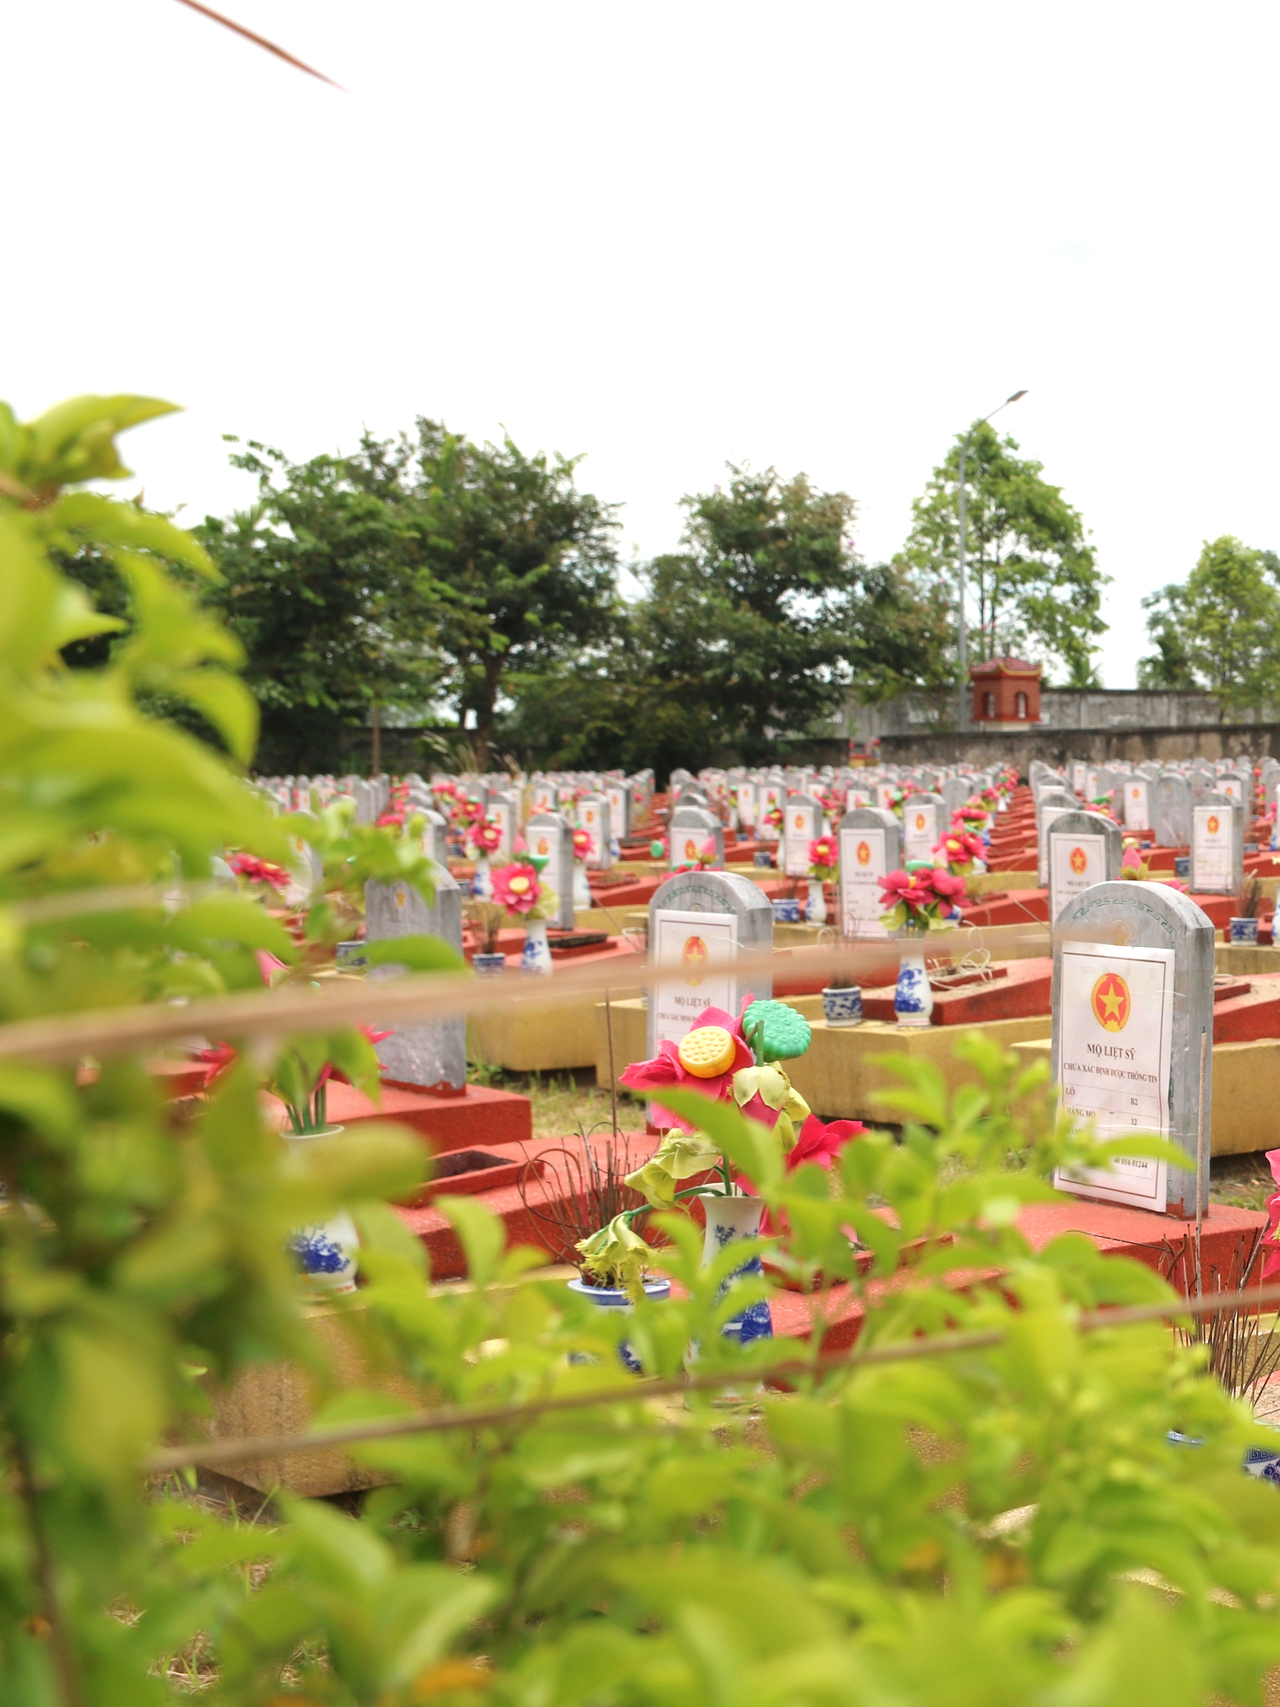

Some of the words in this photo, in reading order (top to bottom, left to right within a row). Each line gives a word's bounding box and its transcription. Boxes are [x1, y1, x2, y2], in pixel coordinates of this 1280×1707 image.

[1087, 1043, 1102, 1057] MỘ
[1104, 1045, 1123, 1060] LIỆT
[1125, 1047, 1136, 1060] SỸ
[1063, 1062, 1081, 1071] CHƯA
[1082, 1063, 1095, 1073] XÁC
[1096, 1067, 1109, 1076] ĐỊNH
[1110, 1069, 1126, 1079] ĐƯỢC
[1127, 1071, 1147, 1082] THÔNG
[1148, 1075, 1158, 1083] TIN
[1130, 1097, 1138, 1106] B2
[1131, 1118, 1137, 1126] 12
[1121, 1158, 1131, 1166] 016
